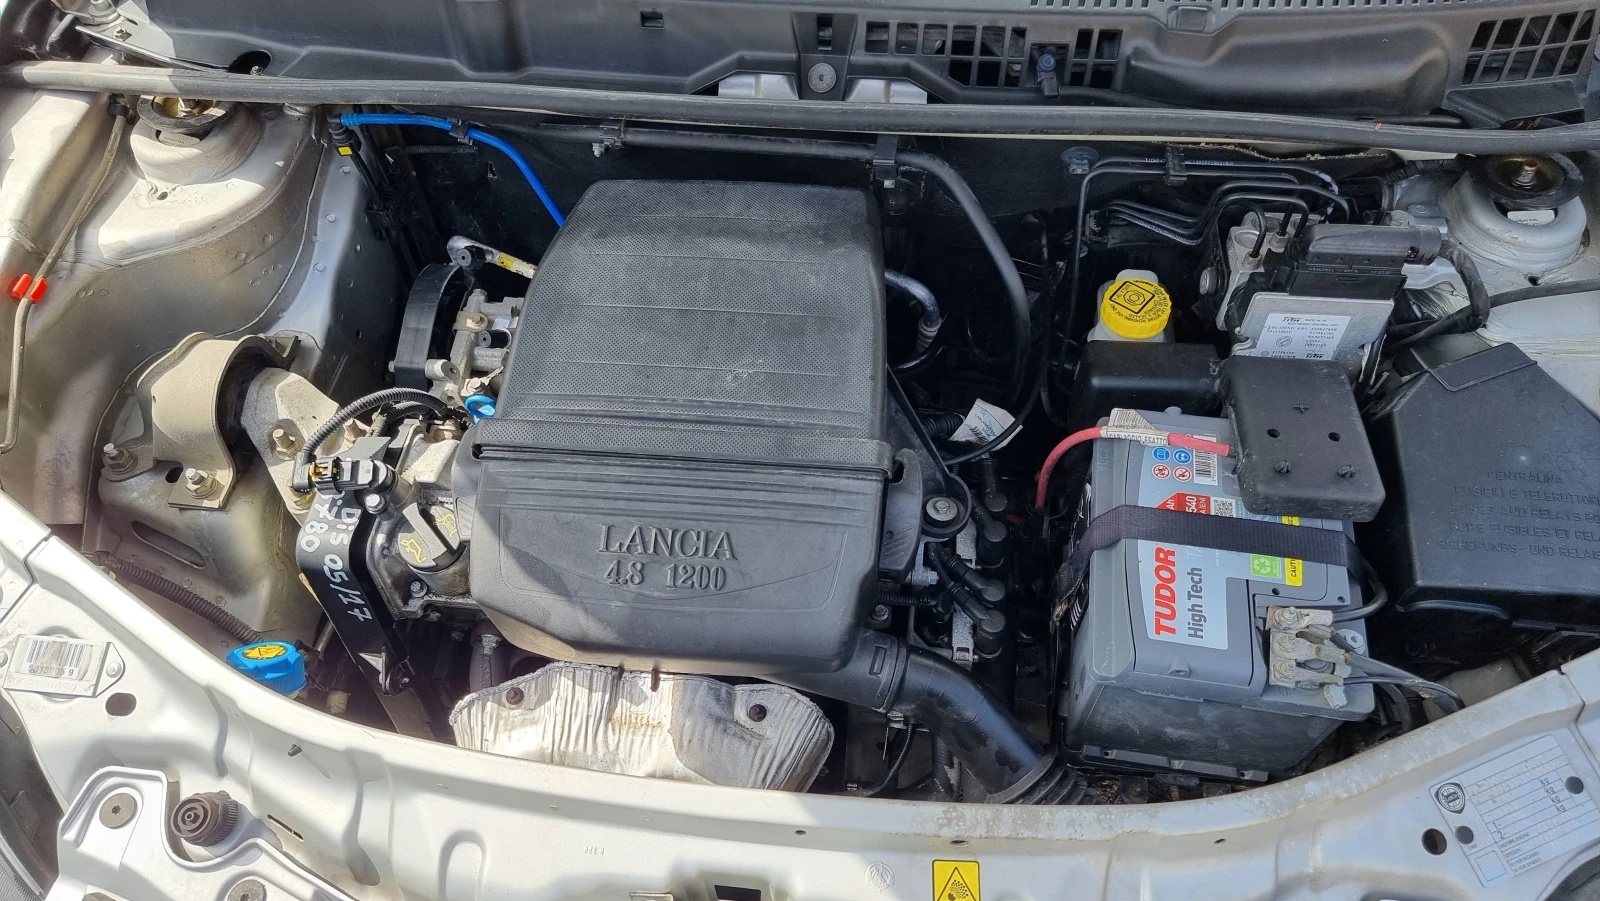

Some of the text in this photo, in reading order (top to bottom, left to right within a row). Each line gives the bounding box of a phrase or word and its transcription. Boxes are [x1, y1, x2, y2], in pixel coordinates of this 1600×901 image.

[1145, 436, 1168, 445] ESATTO
[1488, 470, 1565, 485] CENTRALINA
[1510, 489, 1518, 499] E
[1166, 499, 1175, 510] Ah
[1186, 496, 1197, 514] 540
[1500, 506, 1526, 518] AND
[1530, 508, 1580, 522] RELAYS
[1490, 524, 1550, 538] FUSIBLES
[1554, 527, 1569, 540] ET
[596, 523, 738, 561] LANCIA
[1529, 544, 1554, 556] UND
[604, 559, 726, 592] 4.8 1200
[322, 554, 373, 622] 05/17
[1154, 546, 1177, 636] TUDOR
[1187, 567, 1202, 600] Tech
[1188, 603, 1206, 640] High
[1538, 778, 1550, 786] kg
[1545, 786, 1556, 795] kg
[1550, 795, 1562, 804] kg
[1555, 804, 1566, 813] kg
